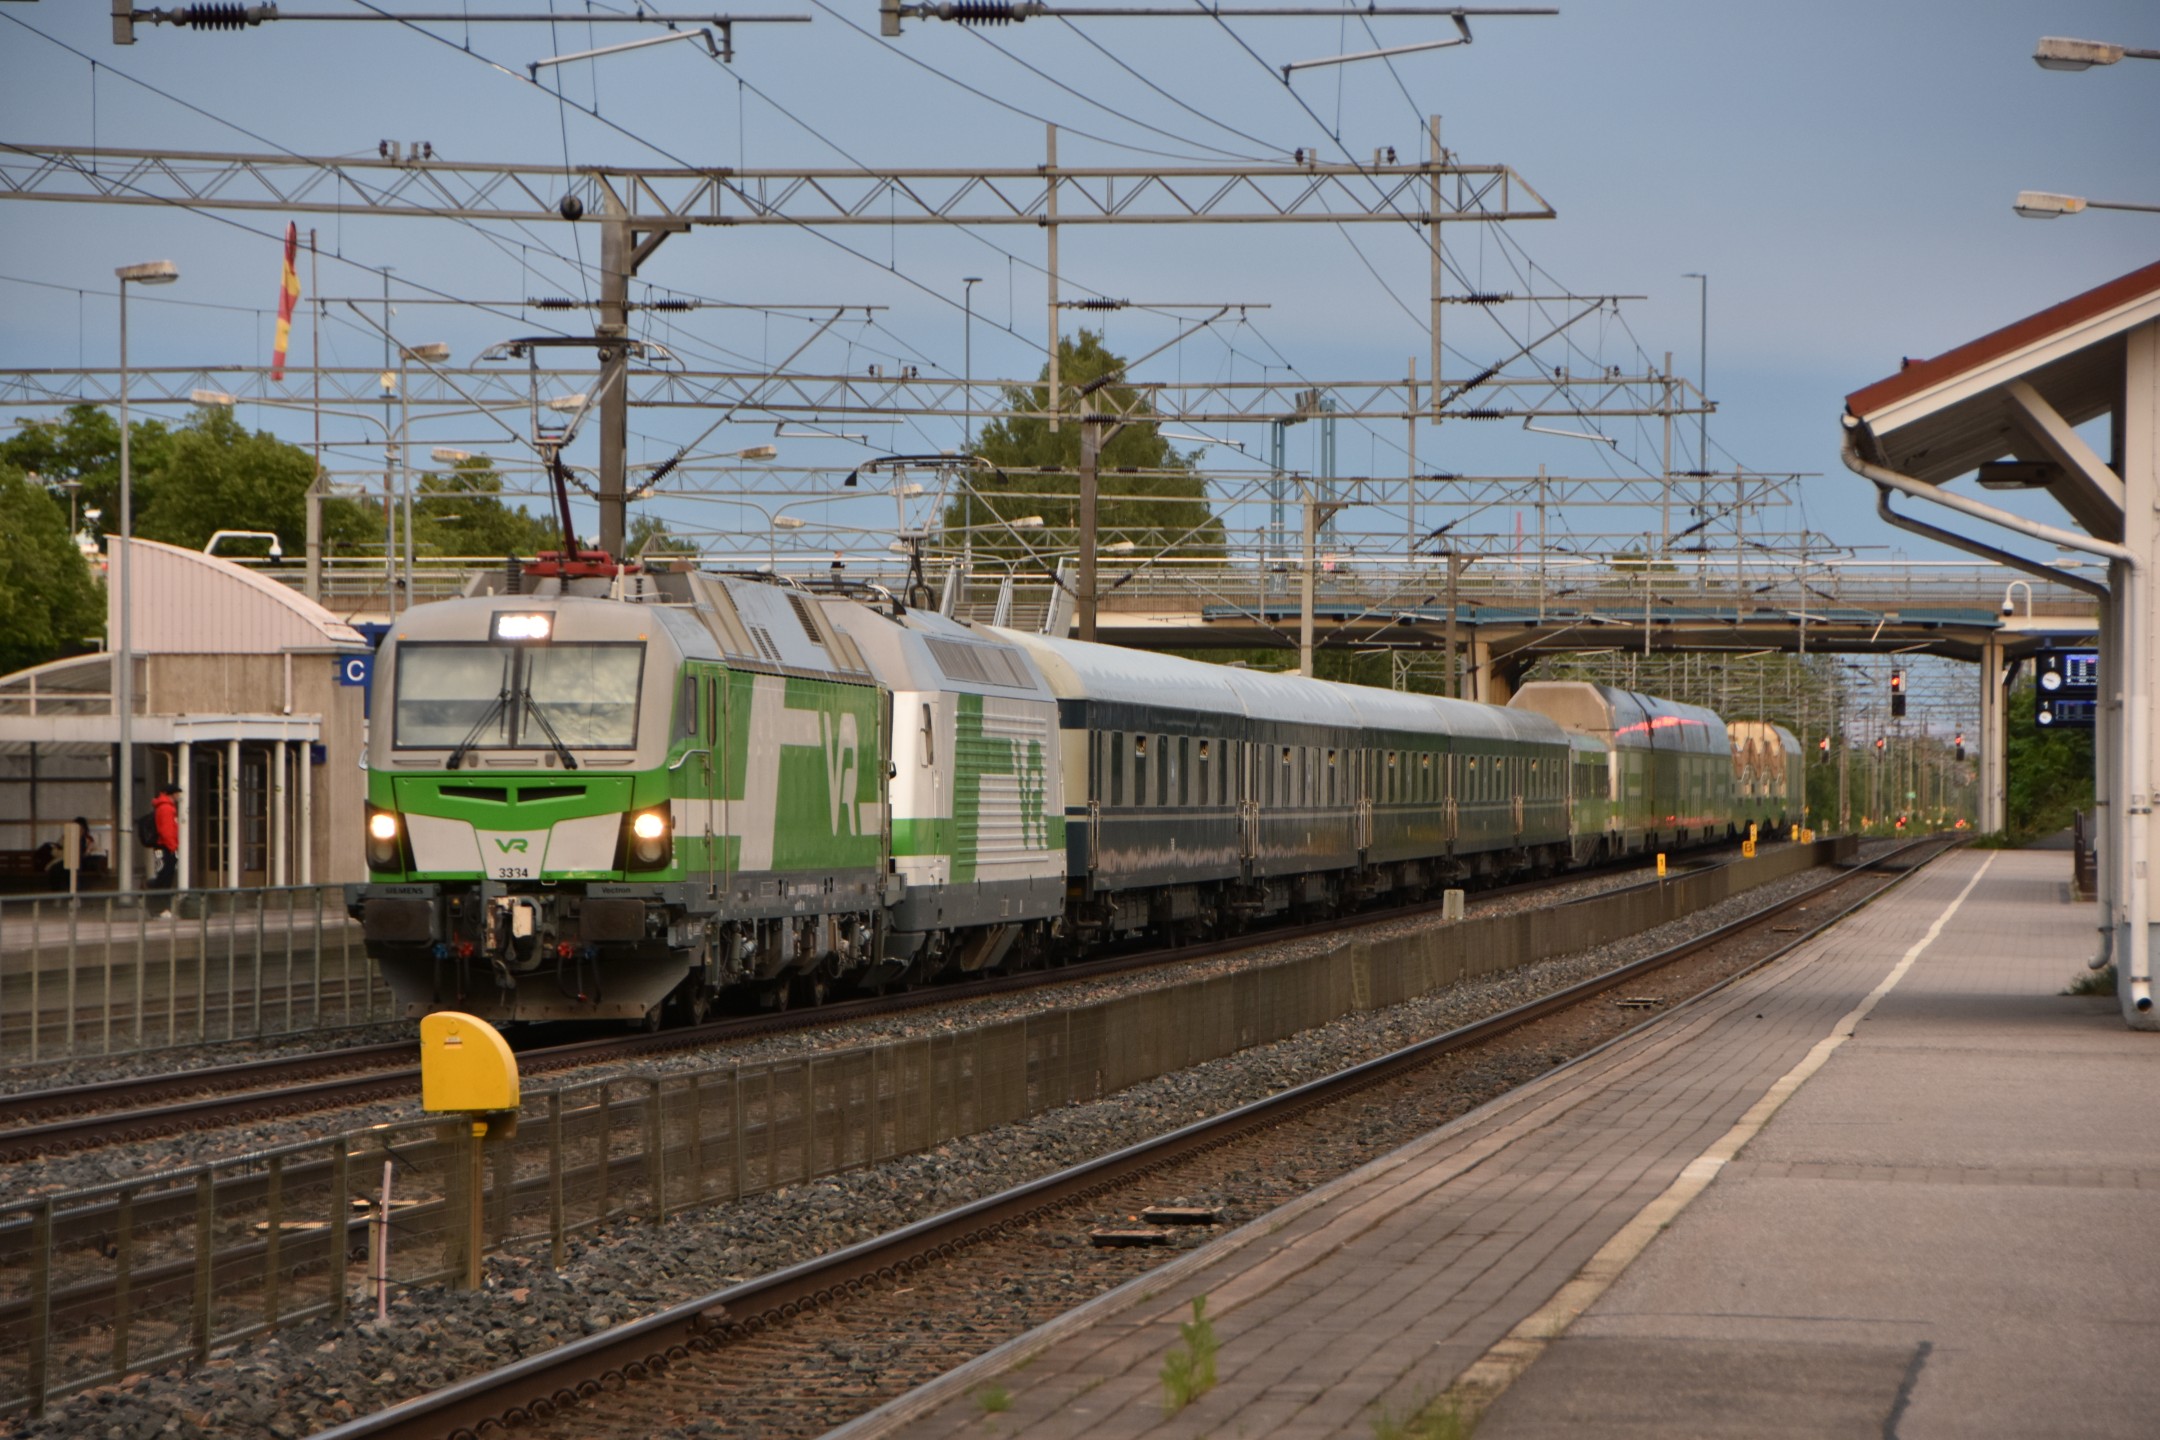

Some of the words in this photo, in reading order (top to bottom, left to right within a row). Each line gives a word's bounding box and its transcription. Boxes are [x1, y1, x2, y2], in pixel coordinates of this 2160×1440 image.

[2049, 656, 2056, 668] 1
[347, 660, 365, 681] C
[824, 711, 859, 837] VR
[494, 838, 528, 854] VR
[498, 867, 529, 878] 3334
[385, 886, 424, 895] SIEMENS
[601, 886, 631, 894] Vectron
